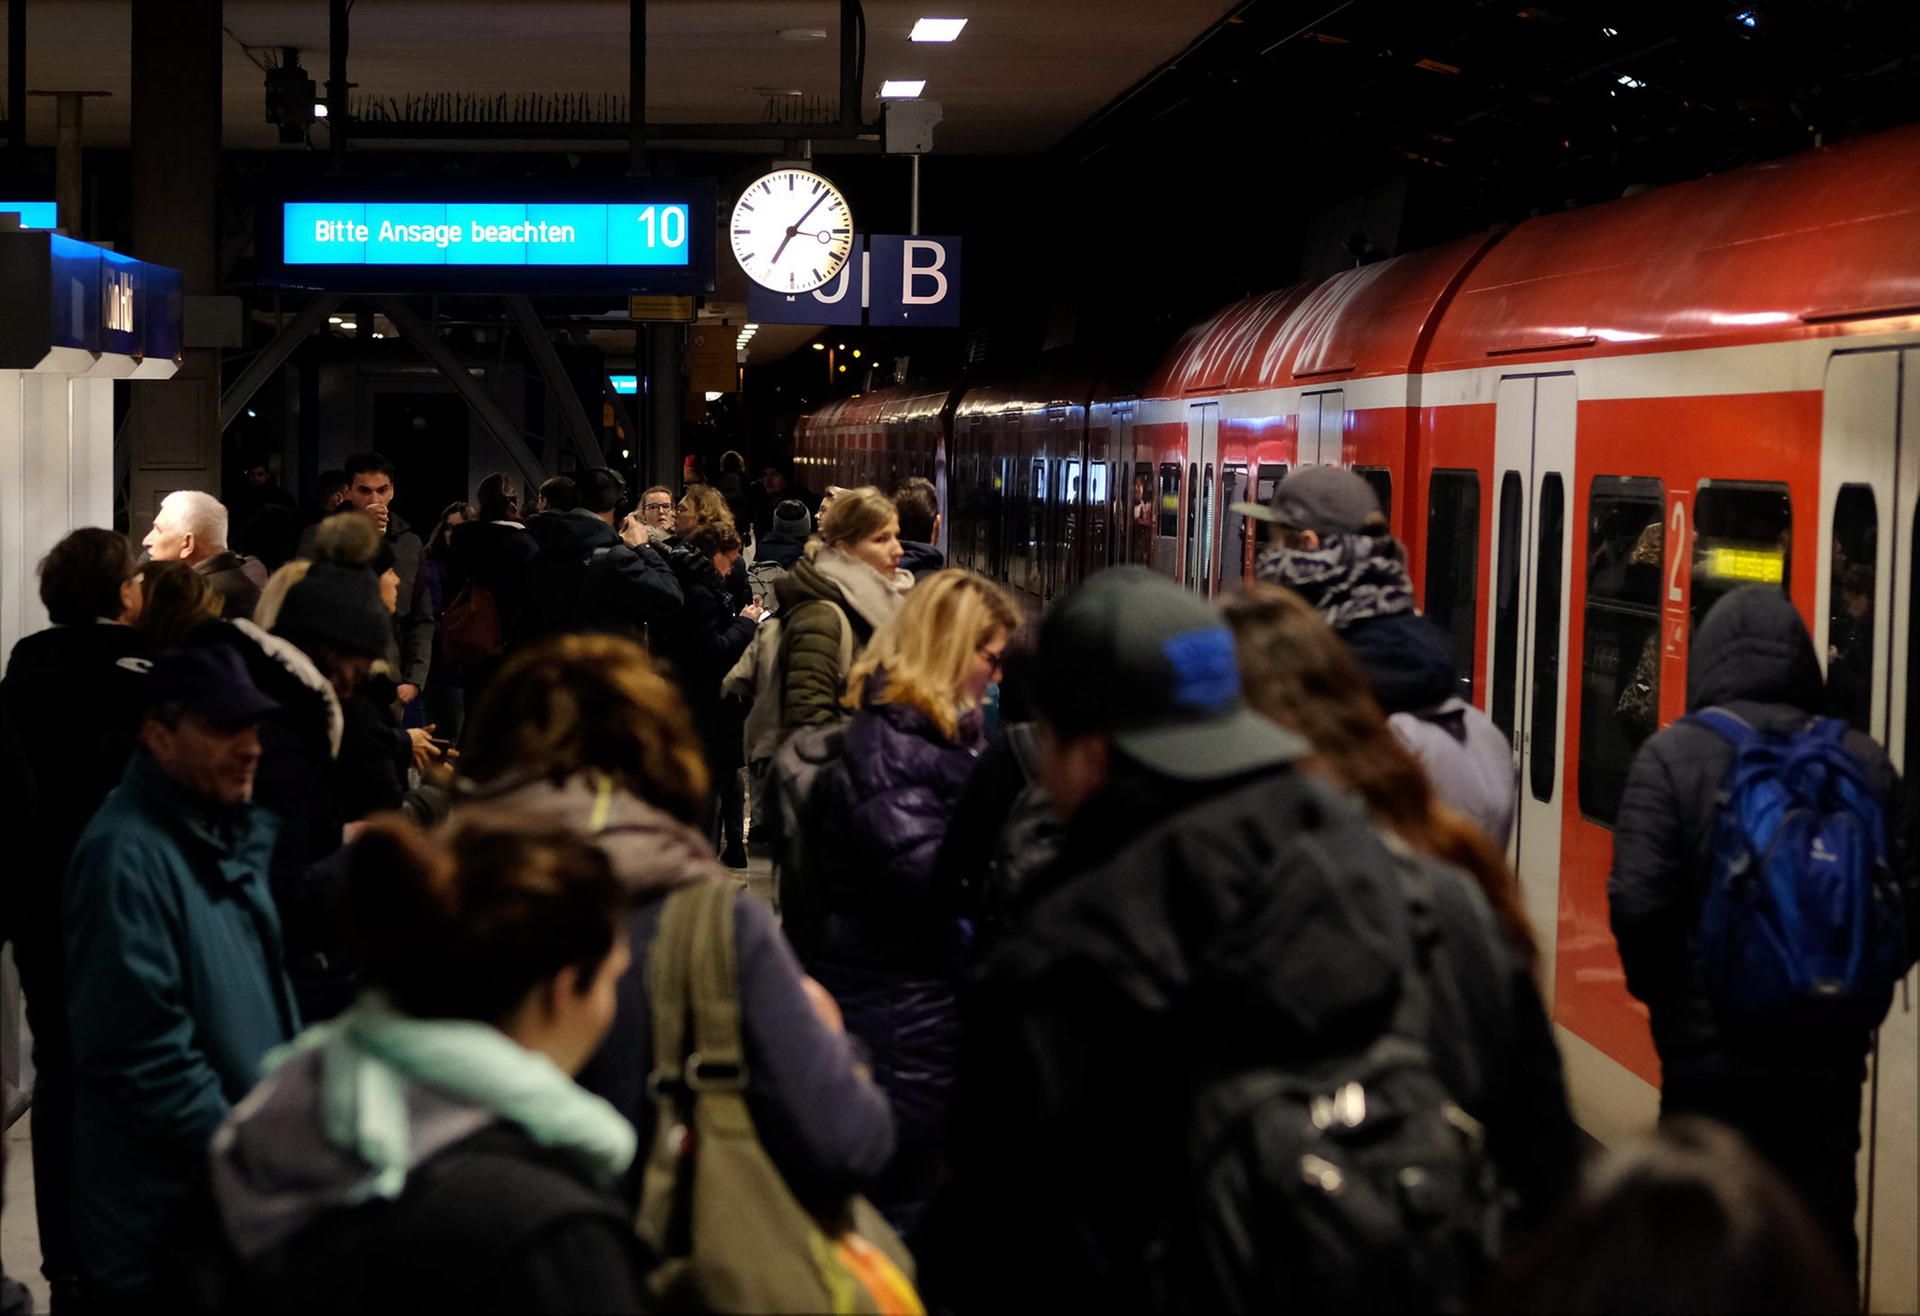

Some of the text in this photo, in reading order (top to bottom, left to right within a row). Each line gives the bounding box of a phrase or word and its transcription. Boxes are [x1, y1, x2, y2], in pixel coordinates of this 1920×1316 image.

[315, 220, 576, 248] Bitte Ansage beachten
[637, 206, 686, 248] 10
[902, 240, 948, 305] B
[1668, 500, 1686, 602] 2
